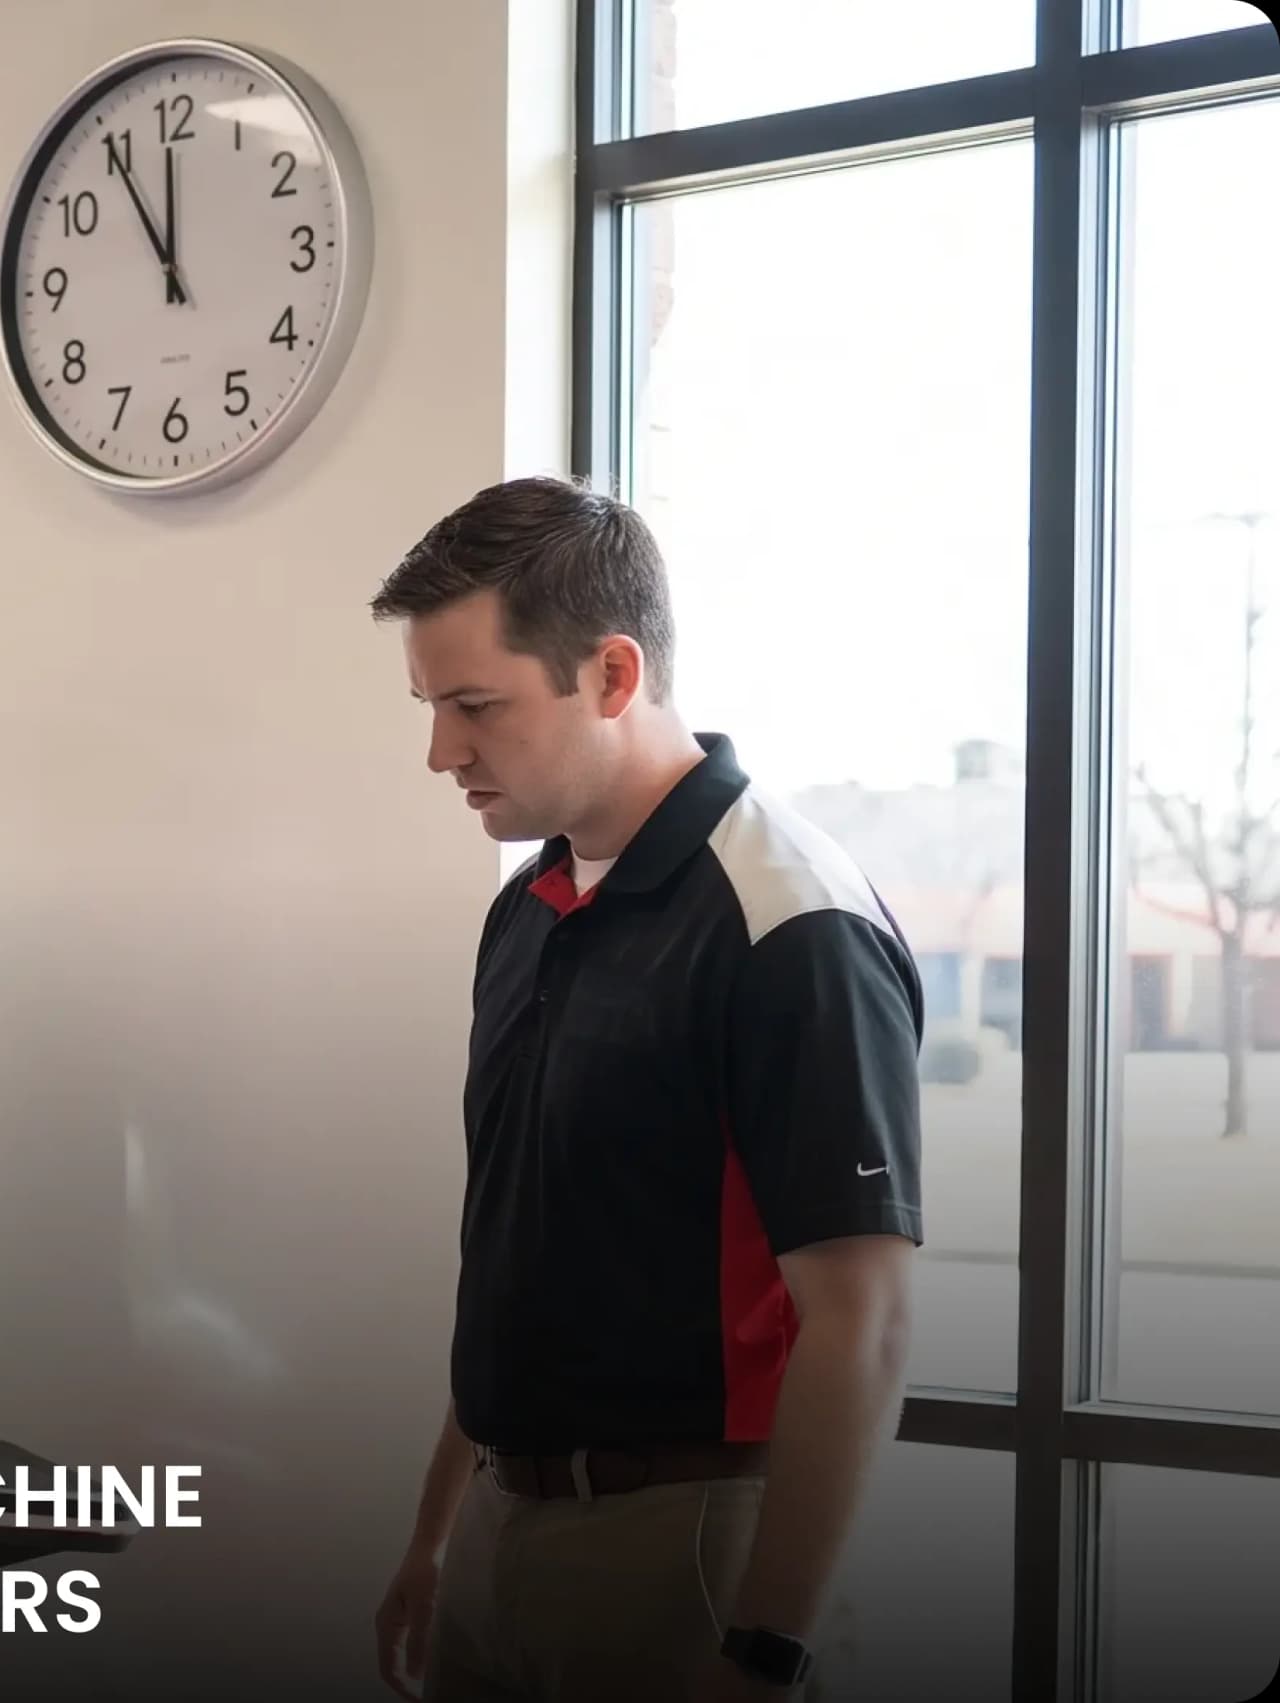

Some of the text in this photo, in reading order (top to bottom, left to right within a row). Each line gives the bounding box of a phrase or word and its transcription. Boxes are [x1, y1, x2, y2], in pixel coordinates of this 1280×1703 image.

[153, 93, 196, 145] 12
[101, 129, 132, 176] 11
[270, 151, 298, 199] 2
[57, 190, 99, 238] 10
[289, 225, 317, 274] 3
[42, 267, 69, 313] 9
[268, 304, 299, 352] 4
[61, 339, 87, 386] 8
[107, 385, 133, 432] 7
[223, 369, 251, 417] 5
[161, 397, 189, 444] 6
